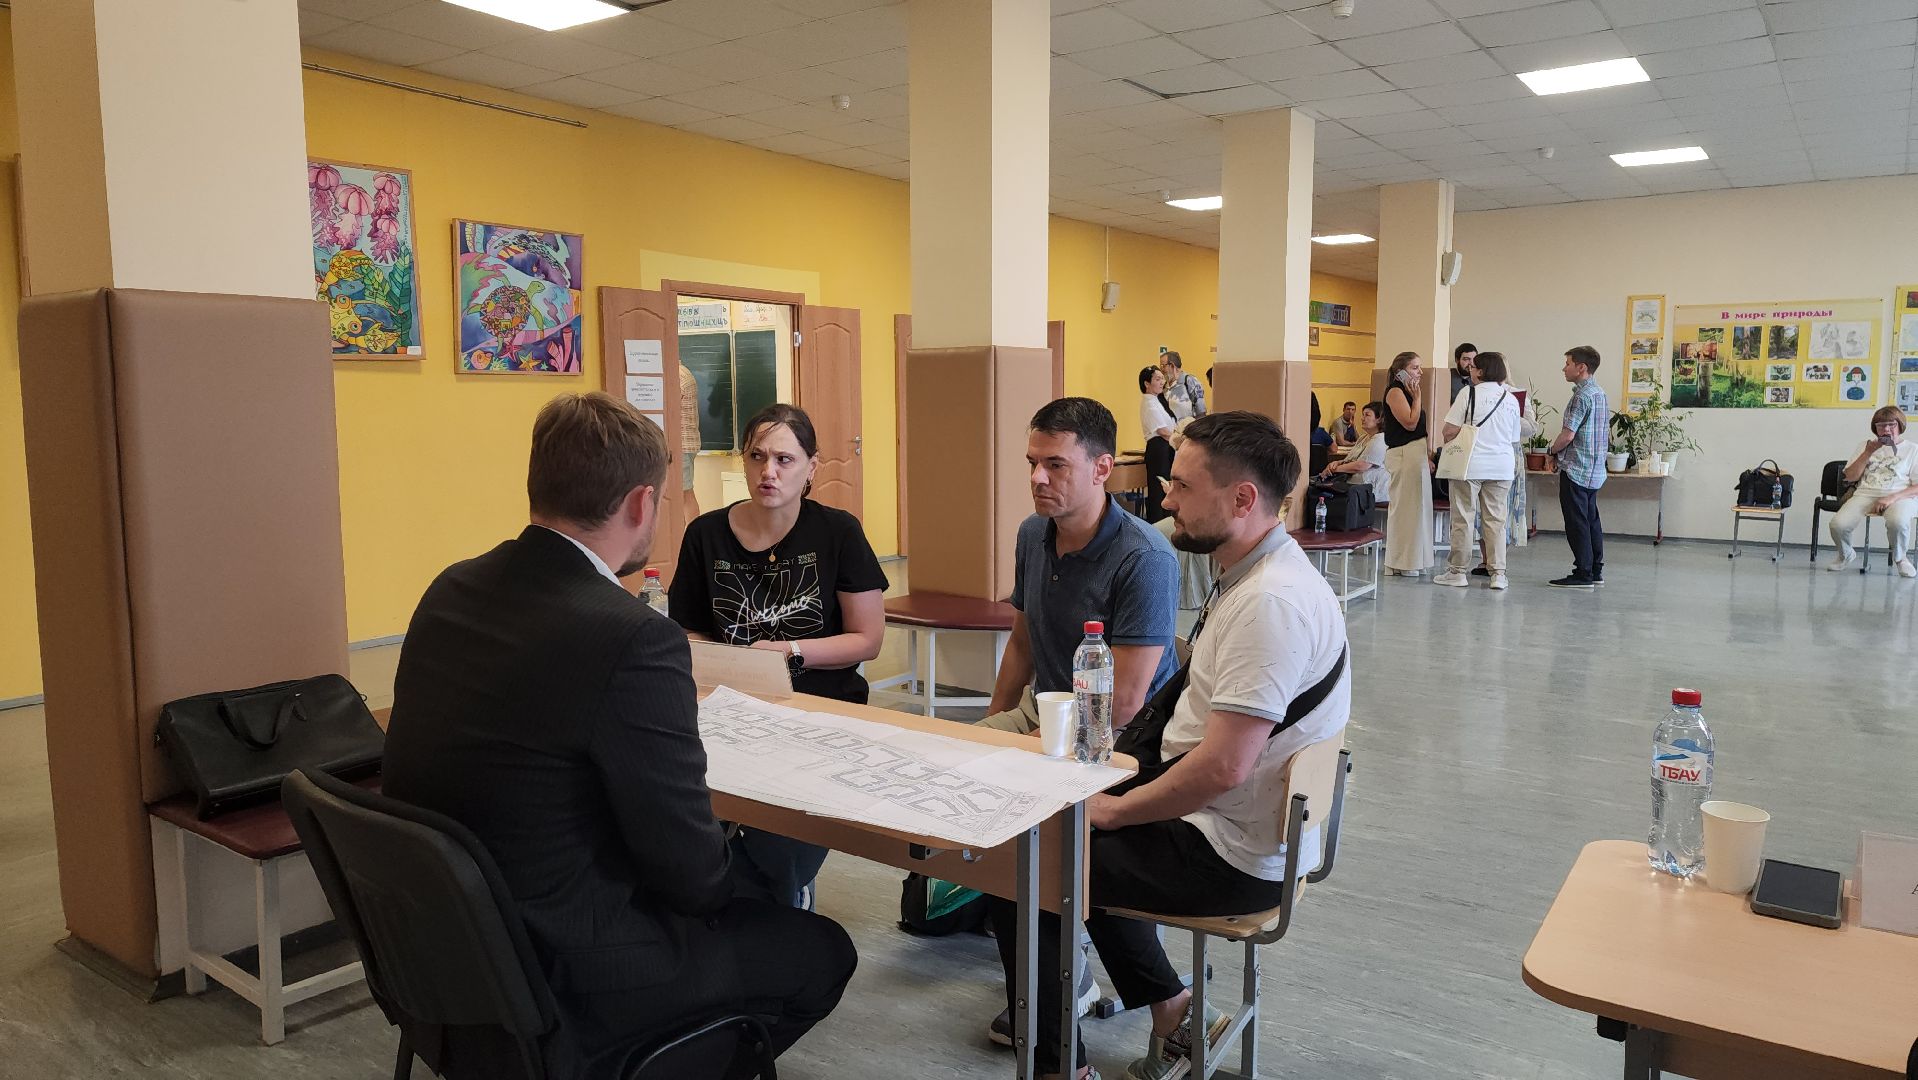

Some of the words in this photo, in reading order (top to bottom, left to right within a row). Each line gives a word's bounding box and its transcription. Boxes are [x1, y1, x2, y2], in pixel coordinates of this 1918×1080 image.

[1721, 311, 1730, 320] В
[1734, 311, 1767, 320] мире
[1772, 309, 1833, 319] природы
[728, 595, 811, 645] Awesome
